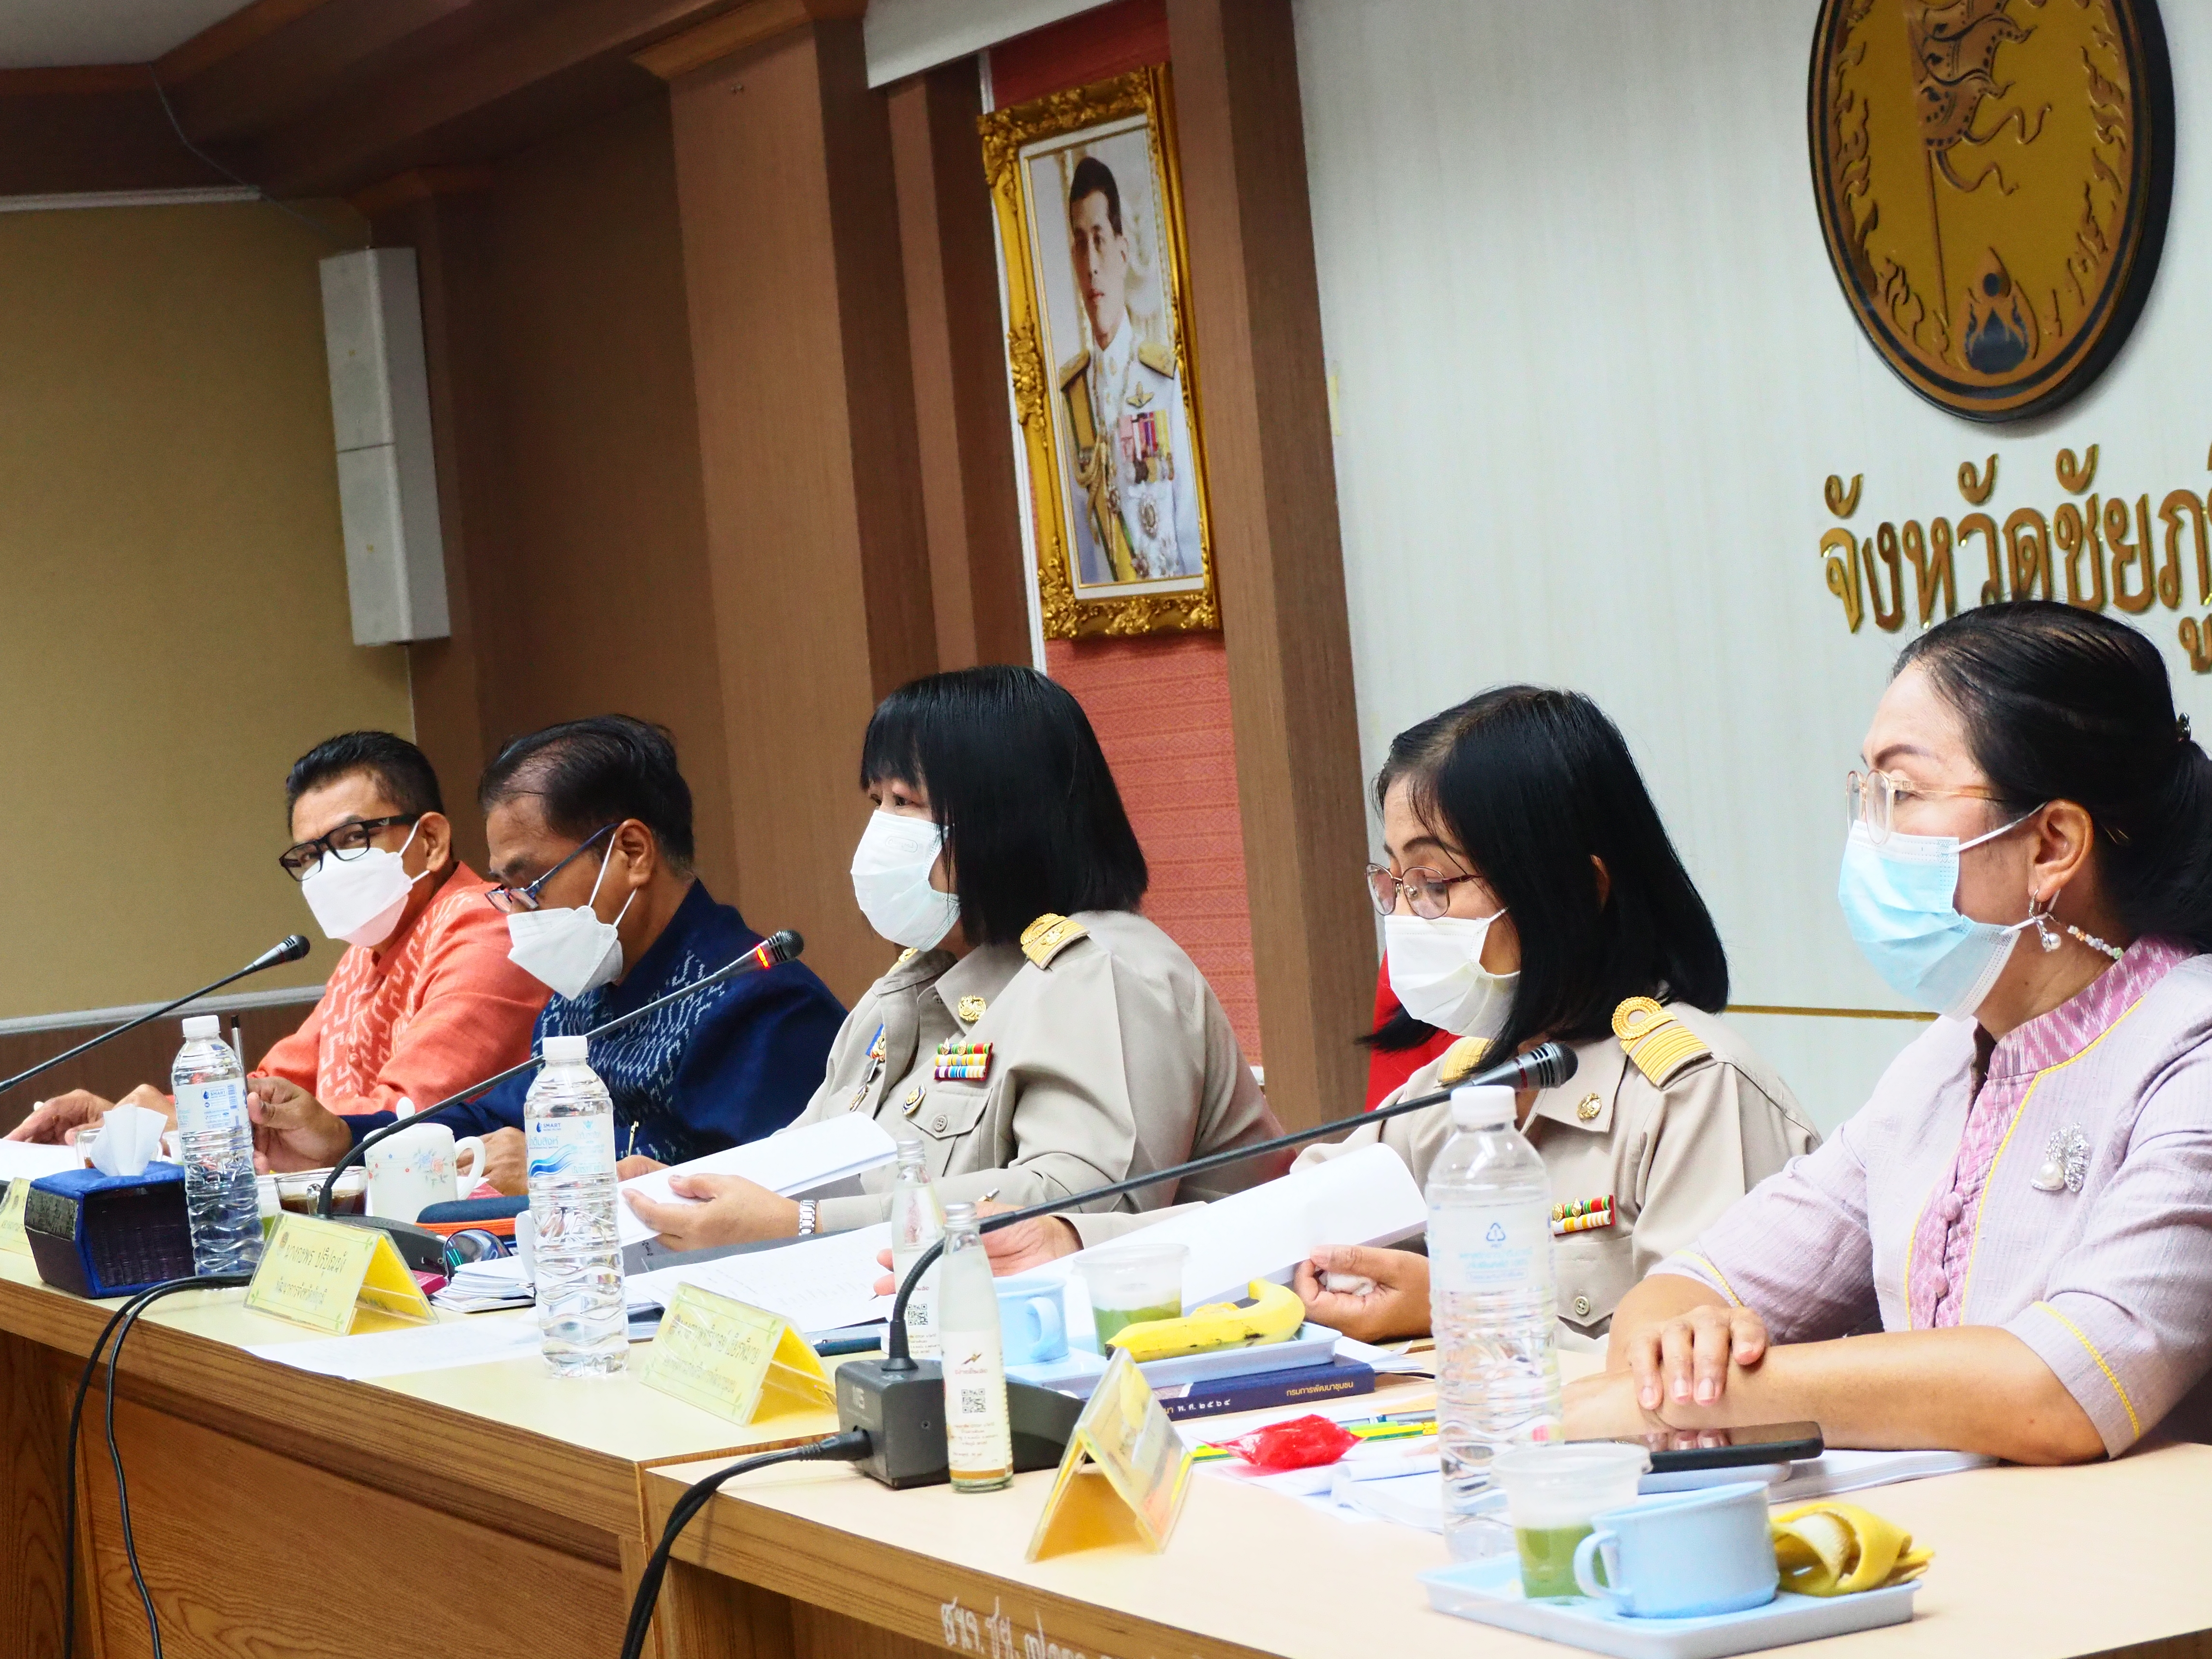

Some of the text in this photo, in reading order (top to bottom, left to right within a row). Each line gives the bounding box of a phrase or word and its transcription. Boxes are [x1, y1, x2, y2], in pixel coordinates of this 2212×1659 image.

[1820, 441, 2212, 673] จังหวัดชัยภู
[1286, 1381, 1354, 1396] กรมการพัฒนาชุมชน
